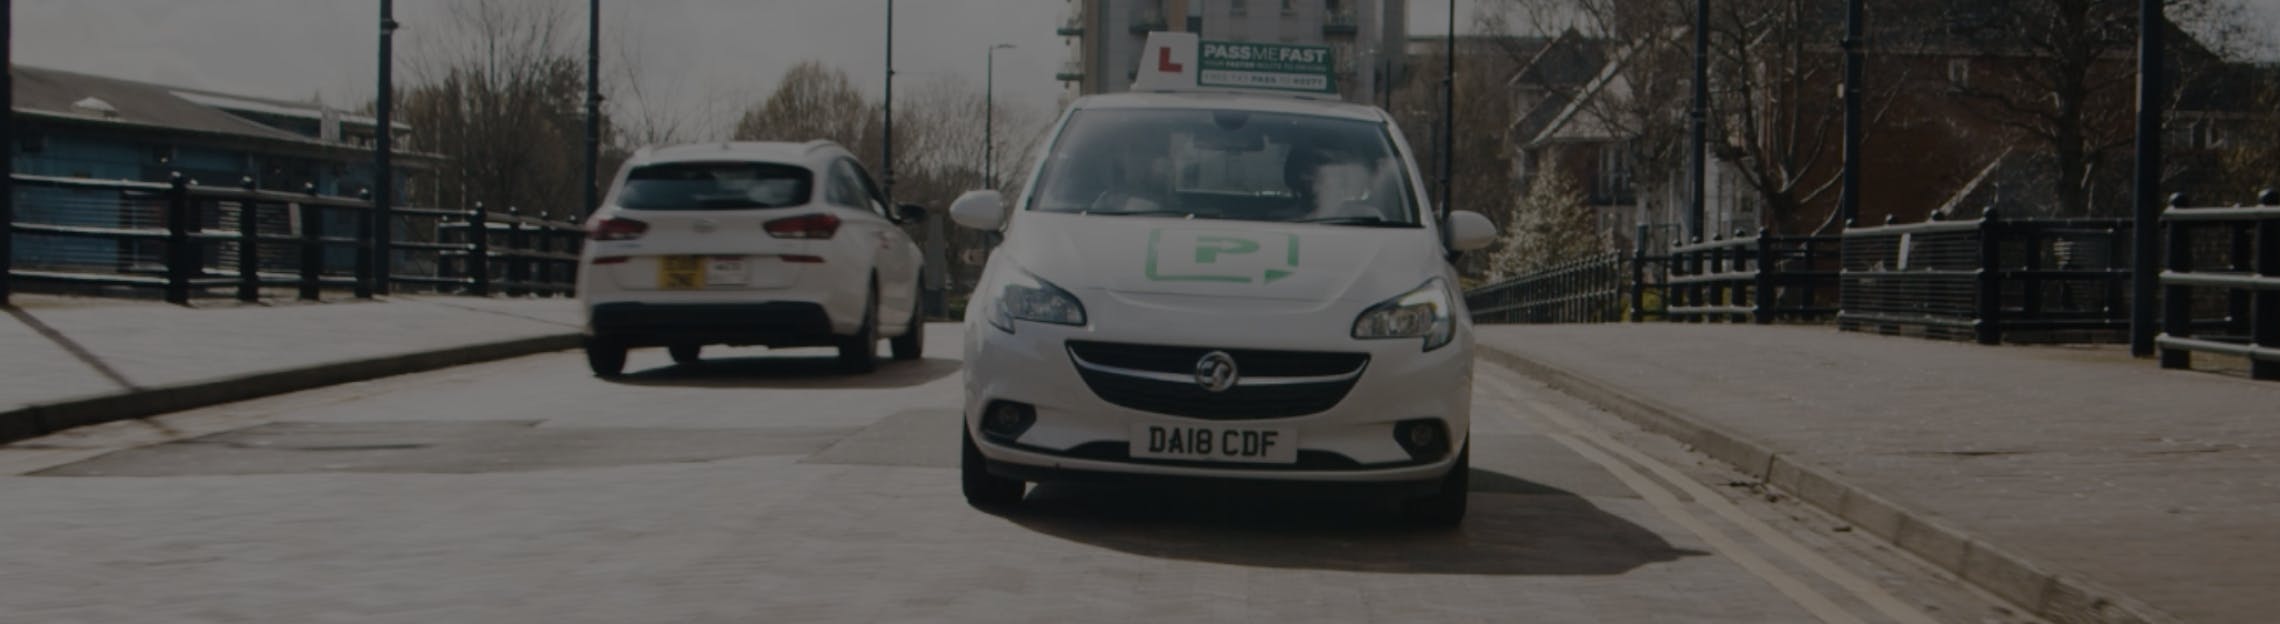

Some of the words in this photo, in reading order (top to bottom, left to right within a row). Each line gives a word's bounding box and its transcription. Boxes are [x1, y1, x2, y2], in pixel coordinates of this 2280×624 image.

[1158, 46, 1183, 73] L
[1195, 236, 1260, 264] P
[1148, 425, 1214, 455] DA18
[1222, 429, 1279, 457] CDF
